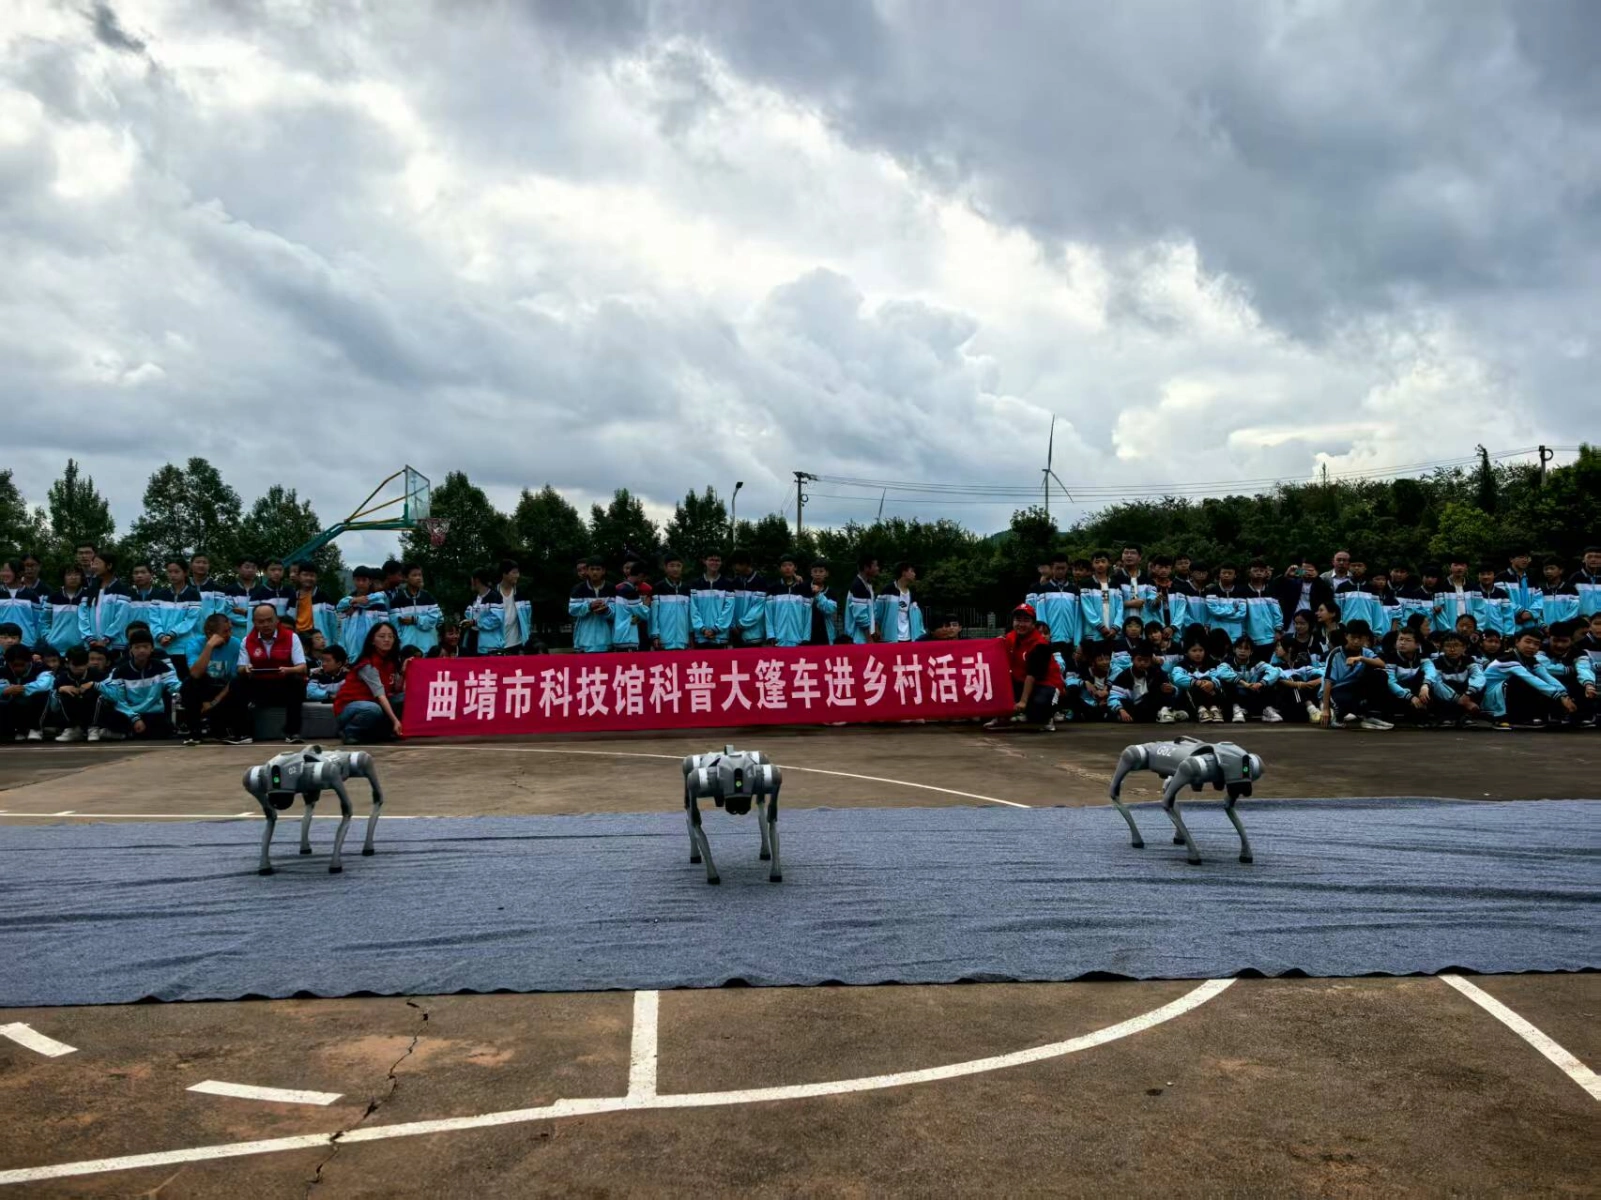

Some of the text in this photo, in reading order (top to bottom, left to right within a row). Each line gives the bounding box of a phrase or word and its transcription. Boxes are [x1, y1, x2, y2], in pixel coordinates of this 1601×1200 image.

[426, 652, 993, 721] 曲靖市科技馆科普大篷车进乡村活动
